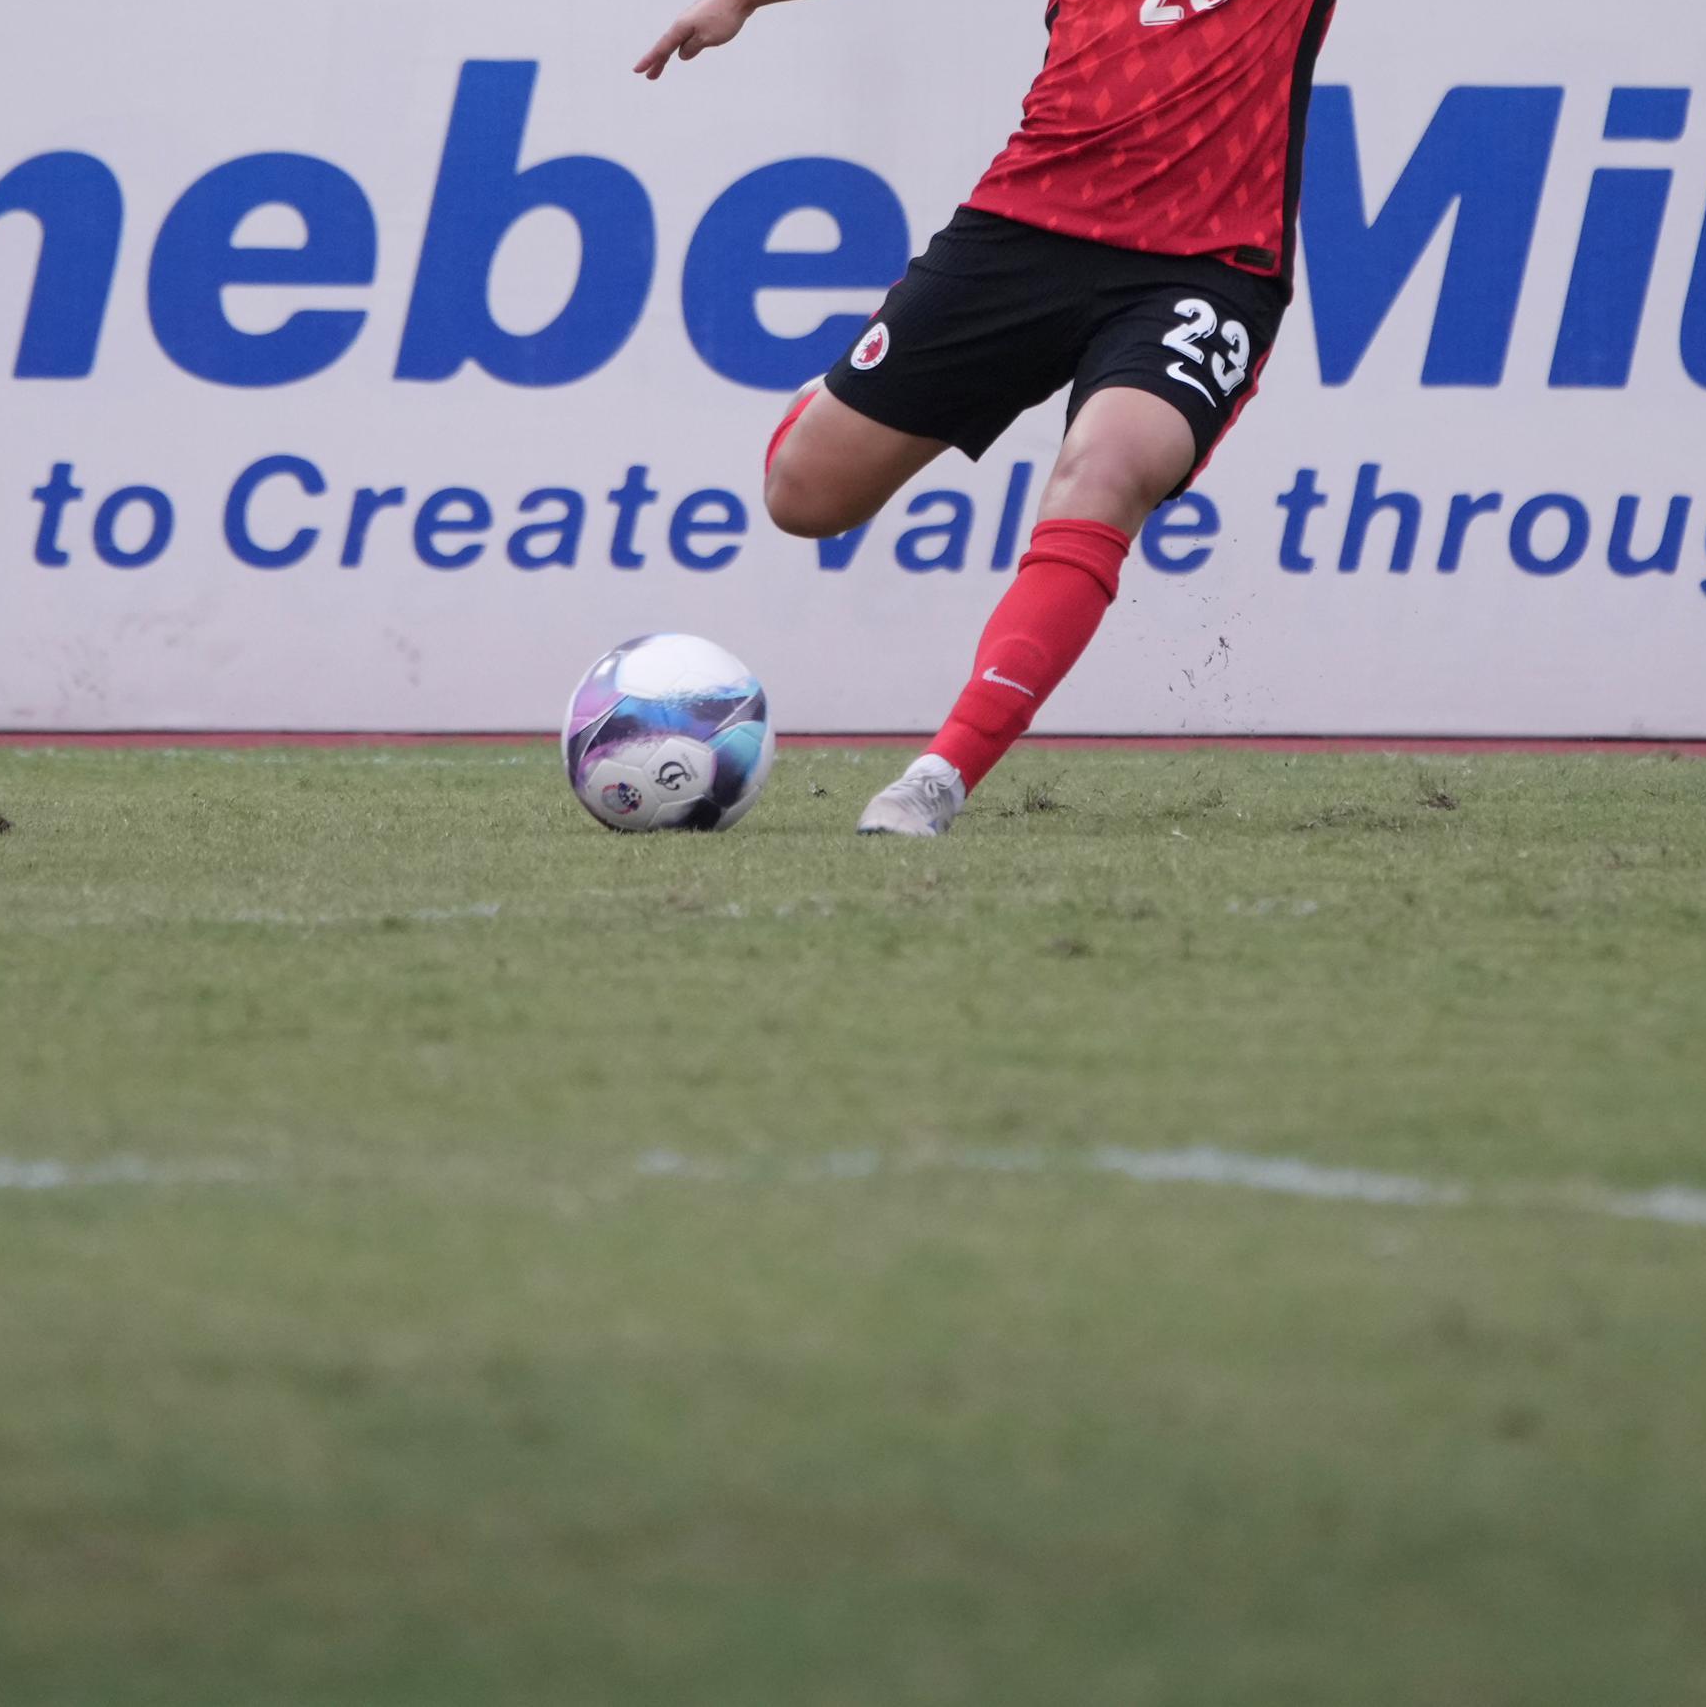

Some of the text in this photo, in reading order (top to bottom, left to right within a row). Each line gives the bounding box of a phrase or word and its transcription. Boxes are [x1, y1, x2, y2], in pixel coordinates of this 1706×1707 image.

[1160, 297, 1251, 397] 23
[32, 461, 174, 569] to
[224, 453, 747, 571] Create
